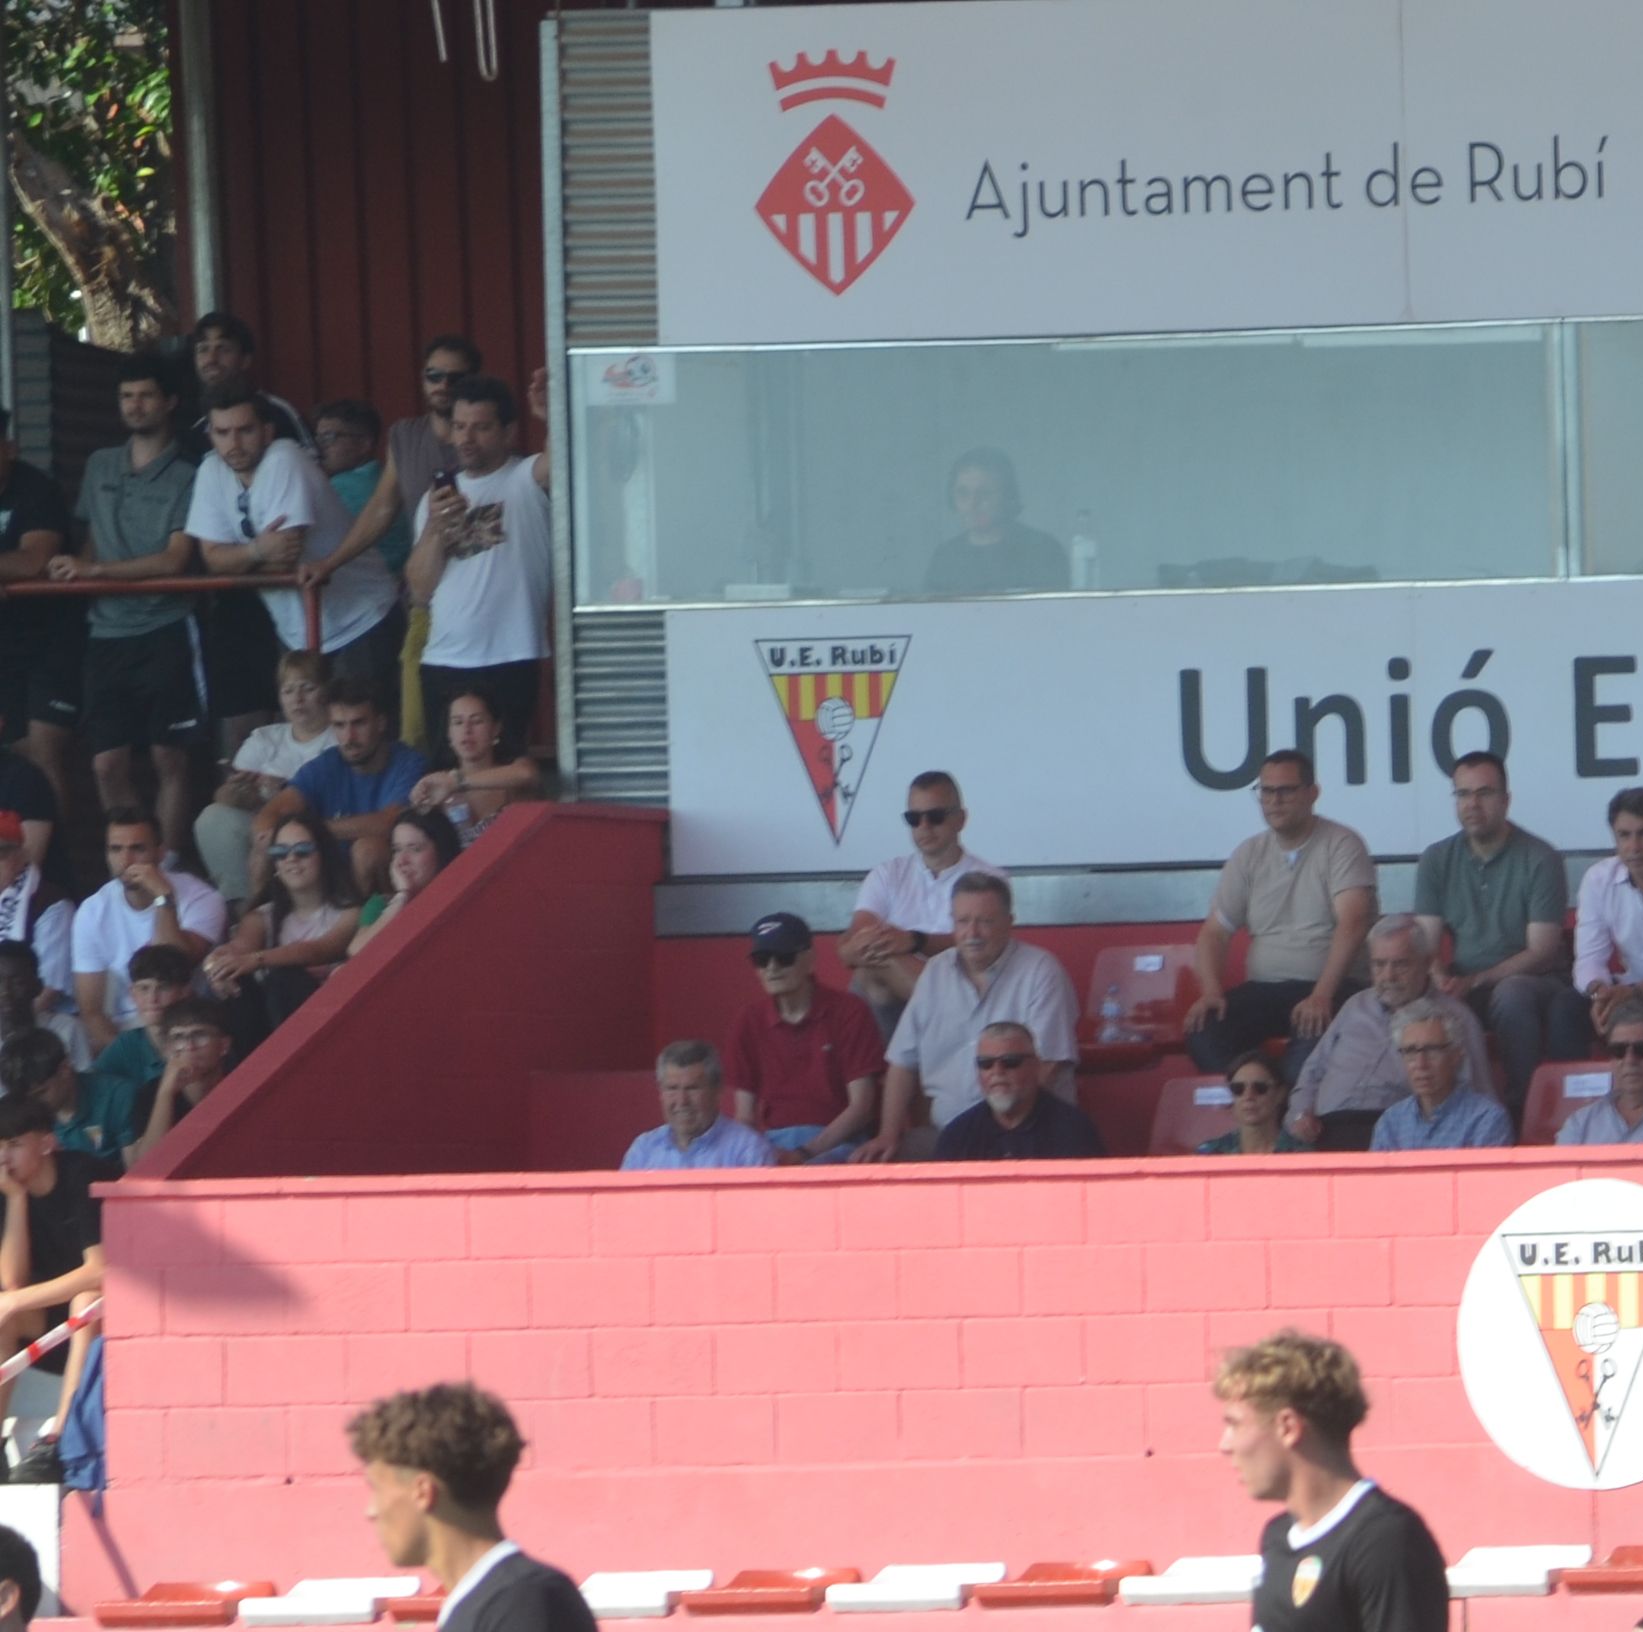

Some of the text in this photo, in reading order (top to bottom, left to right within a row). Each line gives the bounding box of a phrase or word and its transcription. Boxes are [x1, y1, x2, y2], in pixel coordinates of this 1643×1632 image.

[964, 134, 1610, 240] Ajuntament de Rubí
[769, 642, 897, 669] U.E. Rubí
[1179, 649, 1511, 790] Unió
[1518, 1241, 1581, 1267] U.E.
